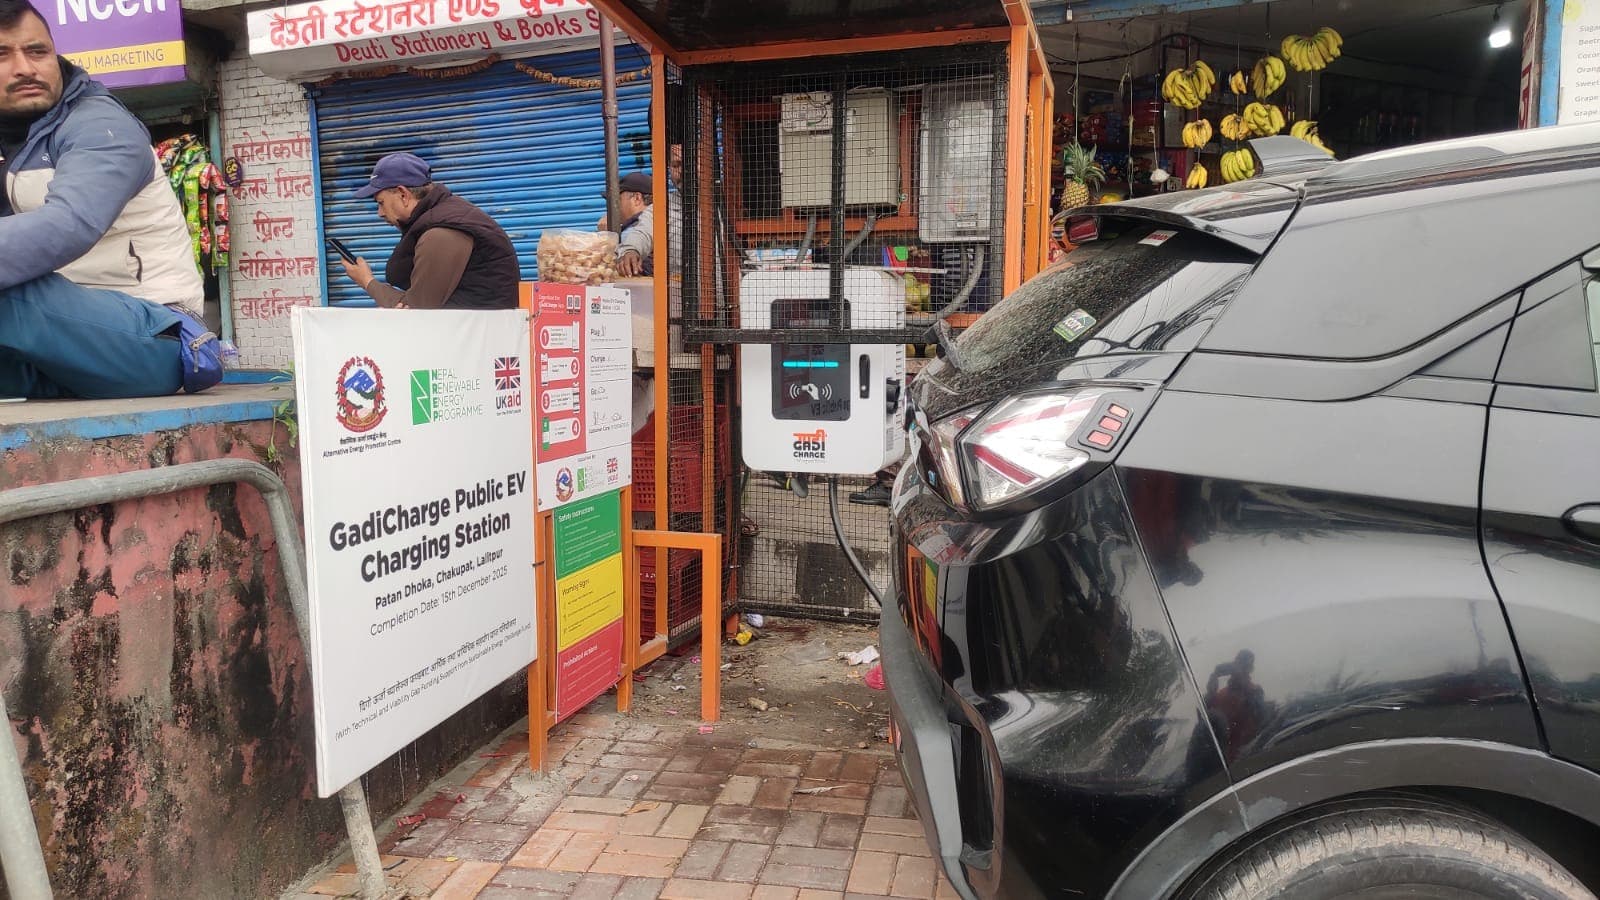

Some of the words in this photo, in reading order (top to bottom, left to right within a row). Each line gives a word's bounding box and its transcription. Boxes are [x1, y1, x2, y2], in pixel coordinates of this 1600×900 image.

[269, 5, 328, 48] देउती
[334, 38, 388, 63] Deuti
[391, 29, 491, 56] Stationery
[493, 21, 516, 41] &
[517, 14, 582, 40] Books
[94, 48, 164, 68] MARKETING
[431, 368, 457, 380] NEPAL
[432, 378, 481, 394] RENEWABLE
[432, 394, 465, 409] ENERGY
[495, 391, 521, 410] UKaid
[433, 404, 483, 422] PROGRAMME
[793, 441, 825, 451] GADI
[329, 497, 451, 551] GadiCharge
[455, 479, 504, 513] Public
[507, 470, 526, 497] EV
[361, 532, 450, 583] Charging
[455, 511, 511, 549] Station
[375, 589, 402, 610] Patan
[404, 576, 435, 597] Dhoka,
[436, 561, 476, 584] Chakupat,
[476, 547, 504, 568] Lalitpur
[370, 607, 419, 636] Completion
[420, 598, 440, 614] Date:
[441, 589, 456, 605] 15th
[457, 574, 492, 597] December
[492, 565, 508, 581] 2025
[352, 709, 378, 732] Technical
[379, 704, 389, 717] and
